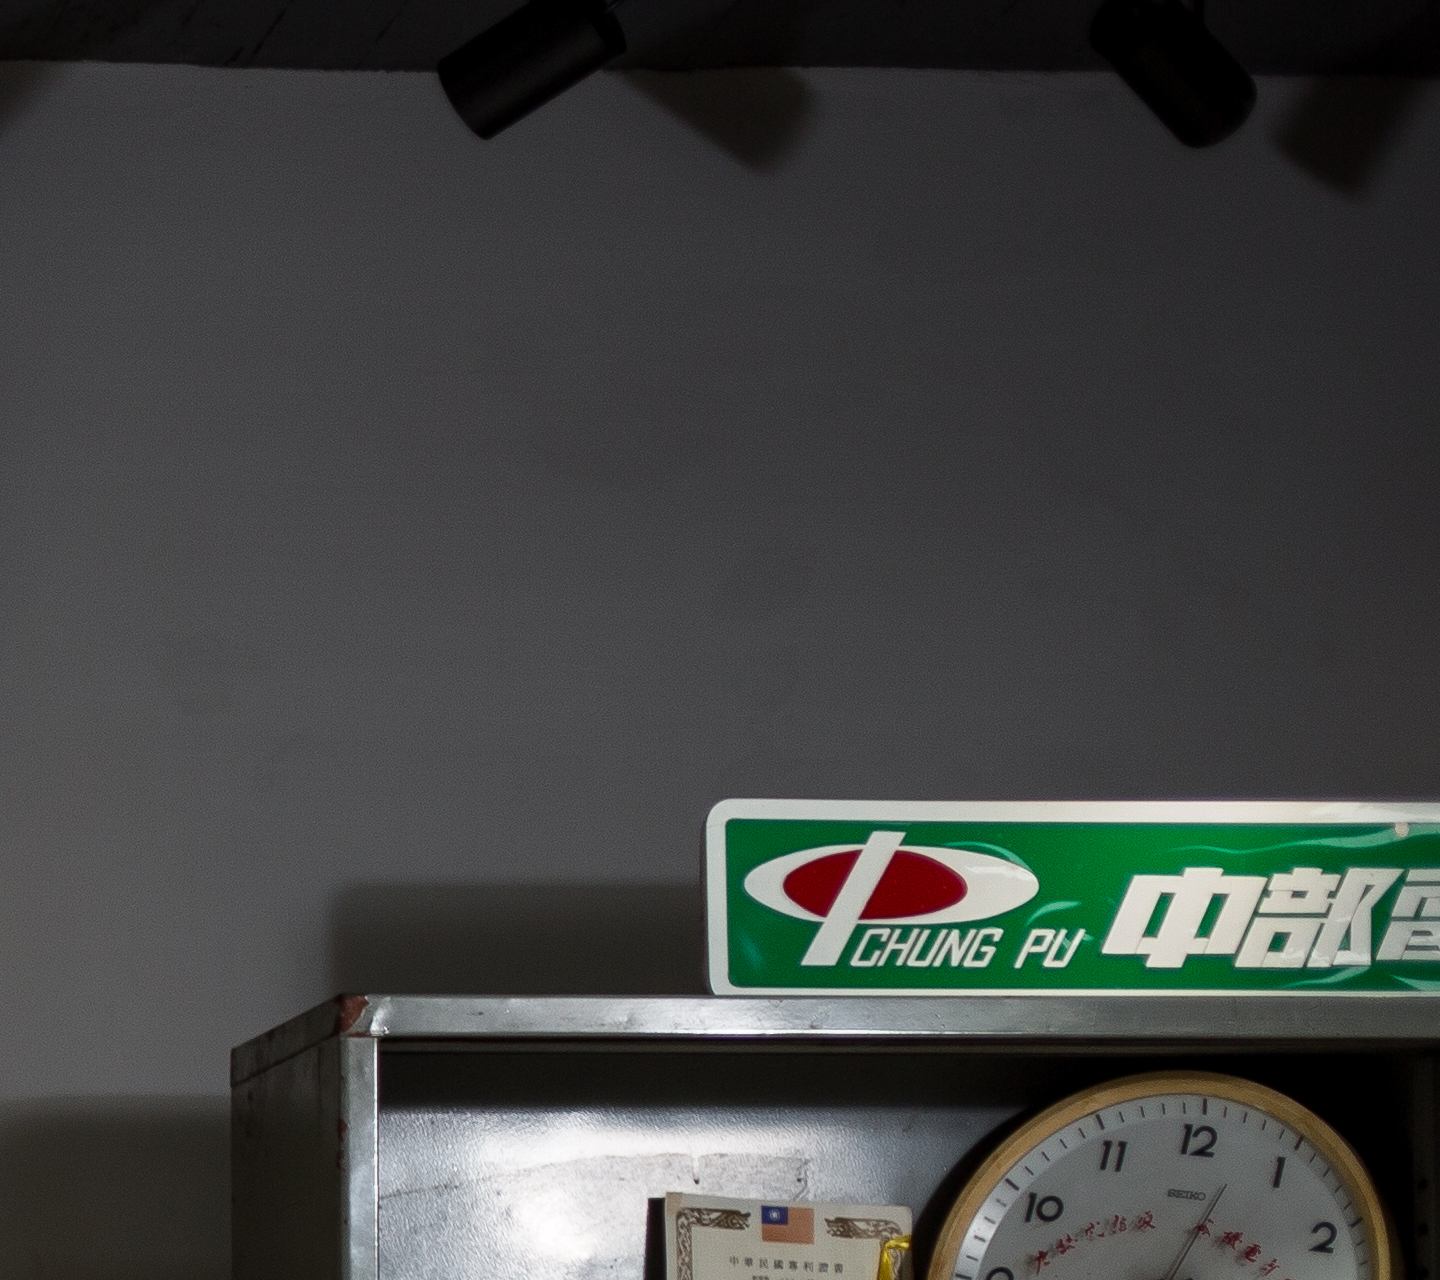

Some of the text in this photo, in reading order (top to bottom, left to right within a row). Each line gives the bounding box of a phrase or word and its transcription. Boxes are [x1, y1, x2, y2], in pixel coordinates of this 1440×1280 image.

[850, 928, 1086, 969] CHUNG PU
[1099, 1140, 1127, 1172] 11
[1180, 1123, 1218, 1158] 12
[1273, 1156, 1286, 1188] 1
[1025, 1192, 1064, 1223] 10
[1166, 1188, 1207, 1201] SEIKO
[1309, 1221, 1338, 1254] 2
